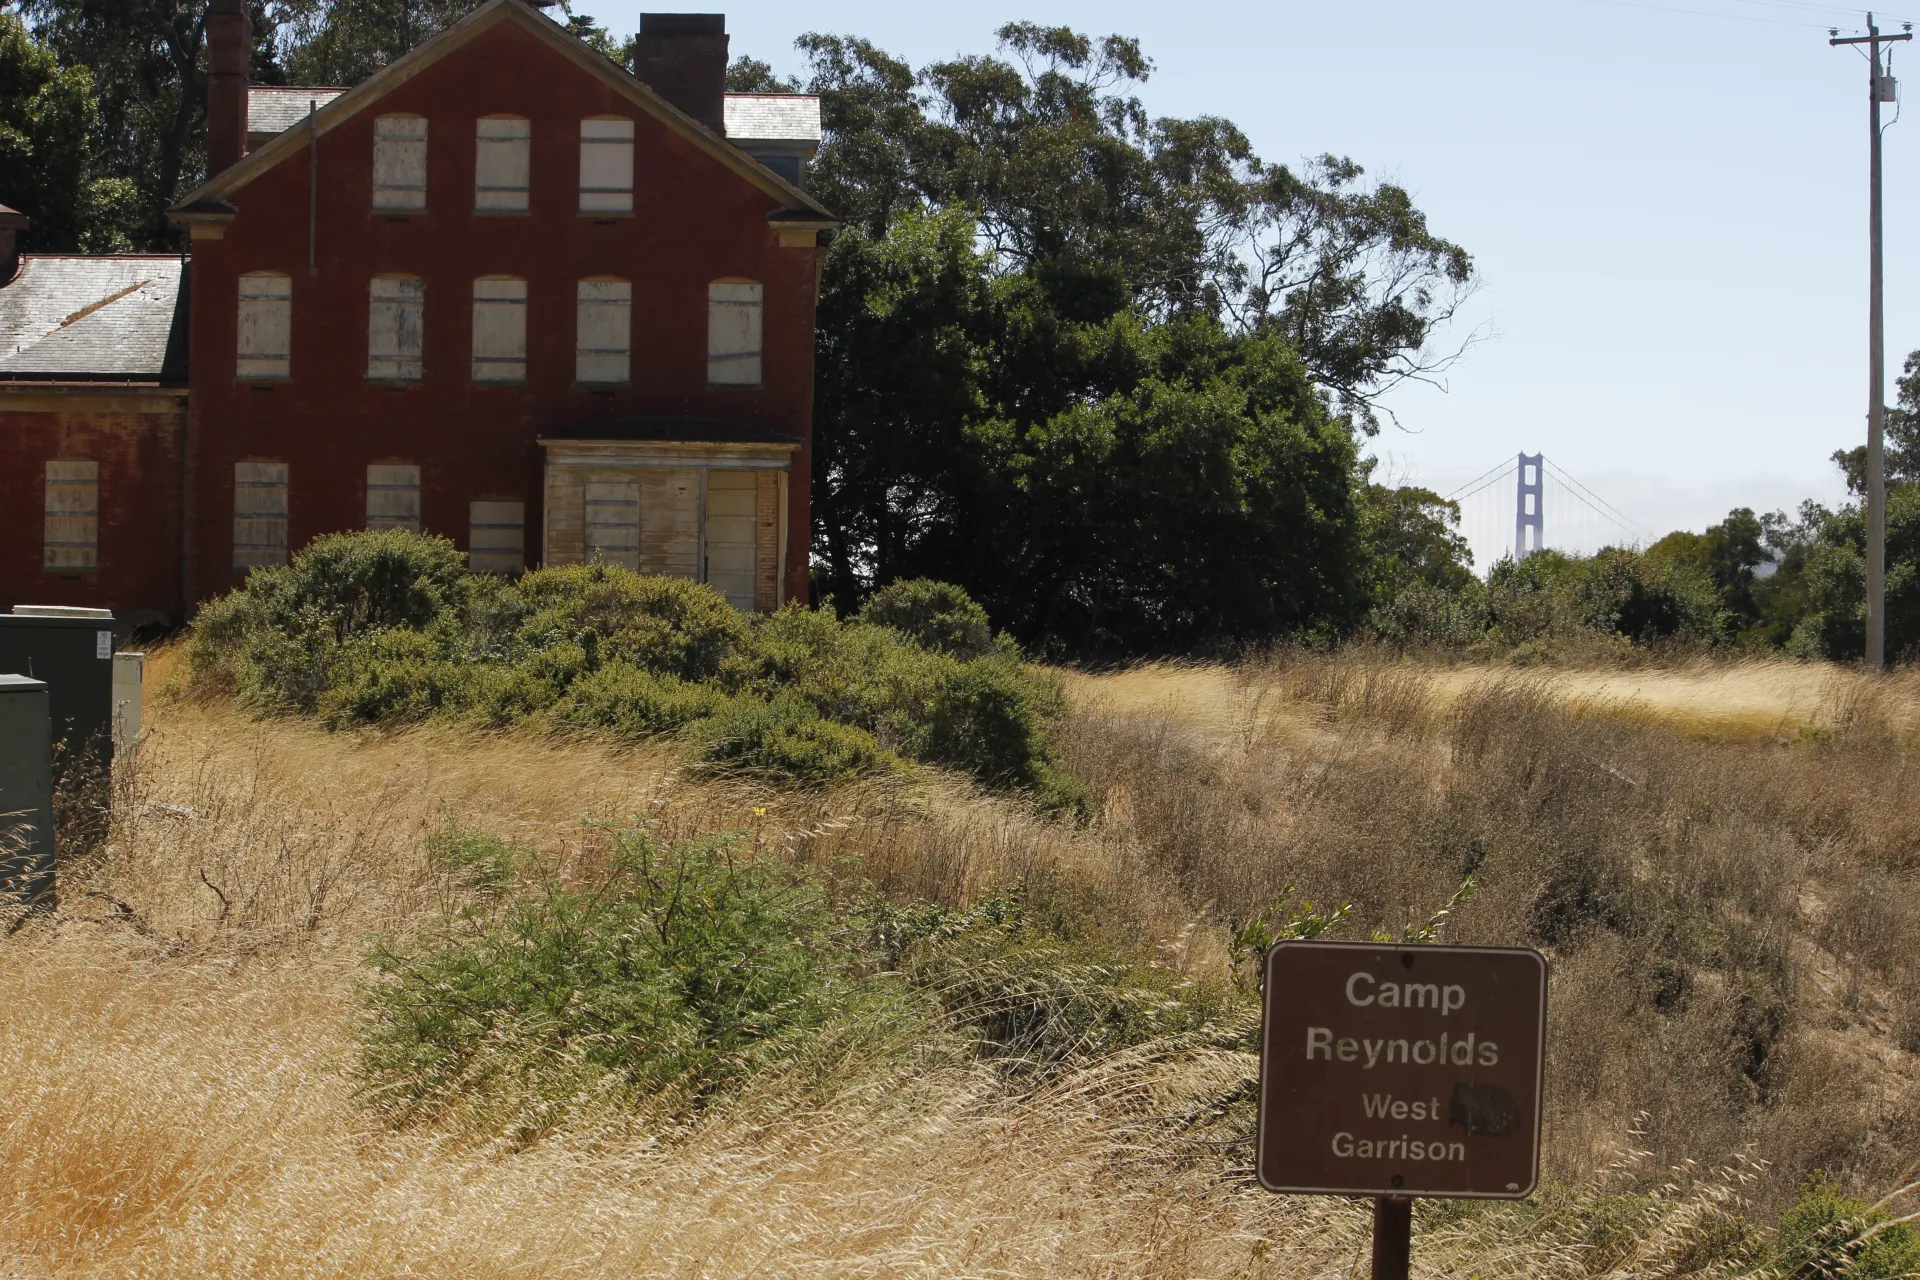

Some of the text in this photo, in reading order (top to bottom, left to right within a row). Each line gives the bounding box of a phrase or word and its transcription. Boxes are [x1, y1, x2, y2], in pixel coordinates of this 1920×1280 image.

[1345, 972, 1466, 1016] Camp
[1306, 1027, 1499, 1069] Reynolds
[1362, 1093, 1440, 1121] West
[1331, 1132, 1466, 1162] Garrison
